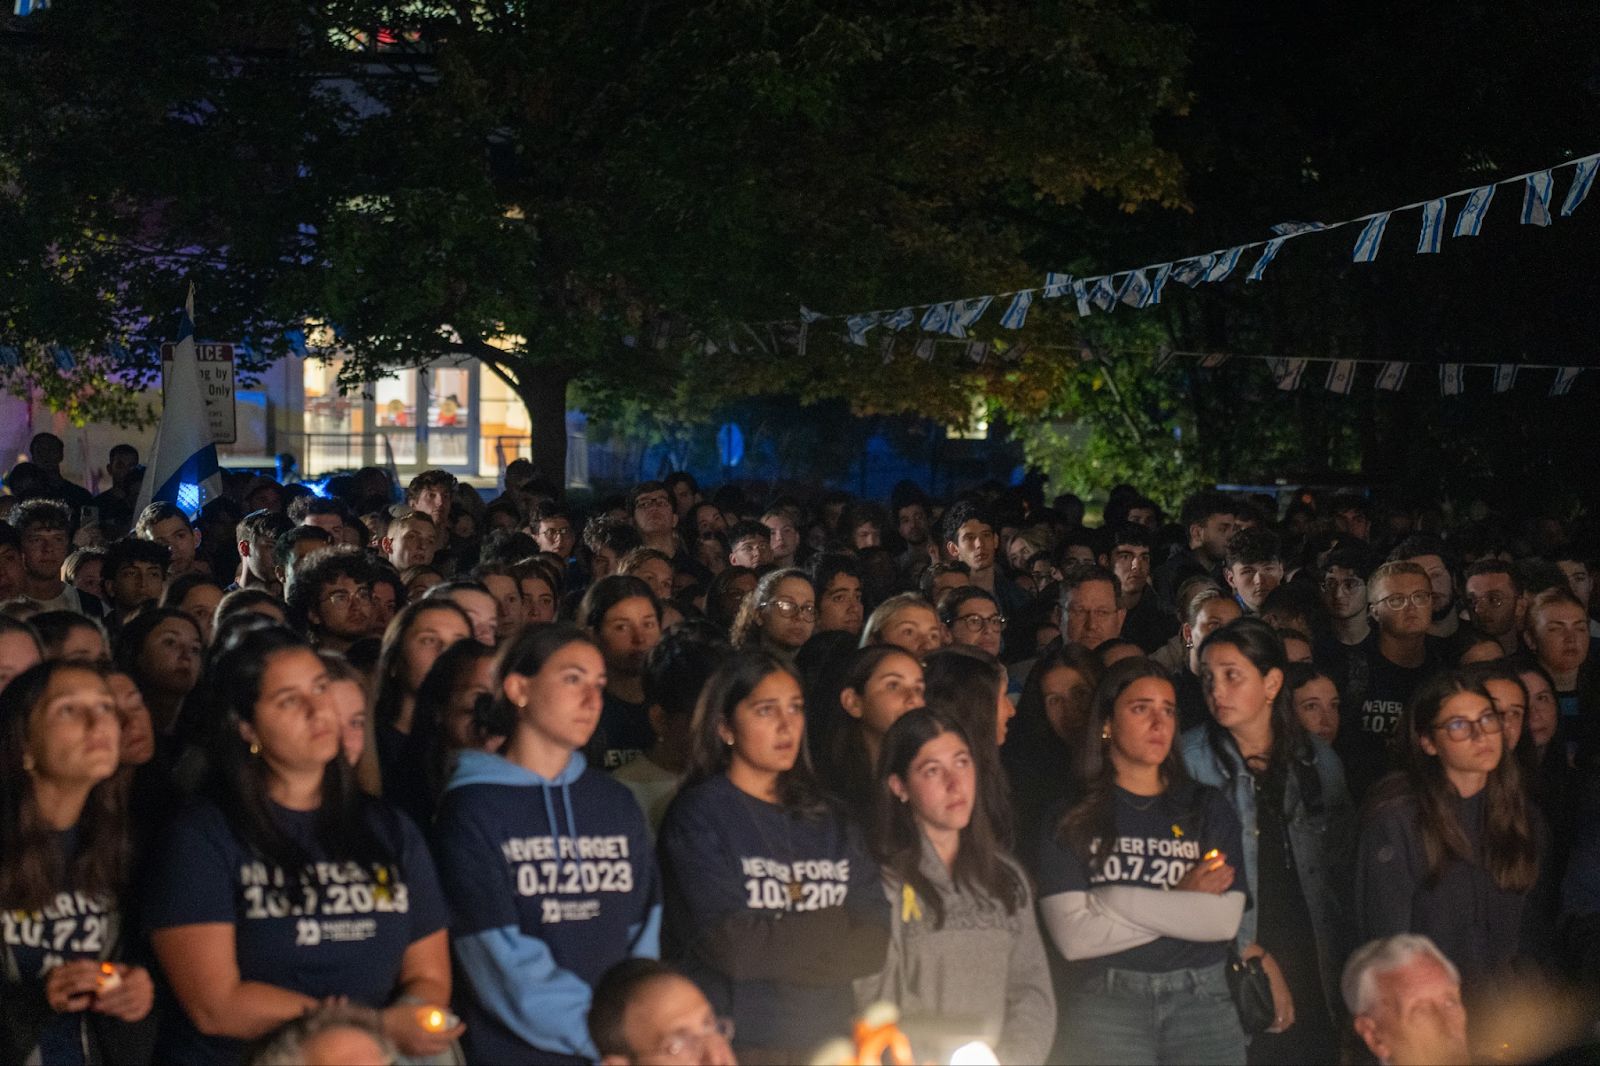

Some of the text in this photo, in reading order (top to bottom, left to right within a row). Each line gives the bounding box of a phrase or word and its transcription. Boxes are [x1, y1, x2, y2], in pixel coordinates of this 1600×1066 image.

[215, 367, 227, 380] by
[208, 384, 231, 397] Only
[1361, 700, 1403, 715] NEVER
[517, 860, 633, 896] 0.7.2023
